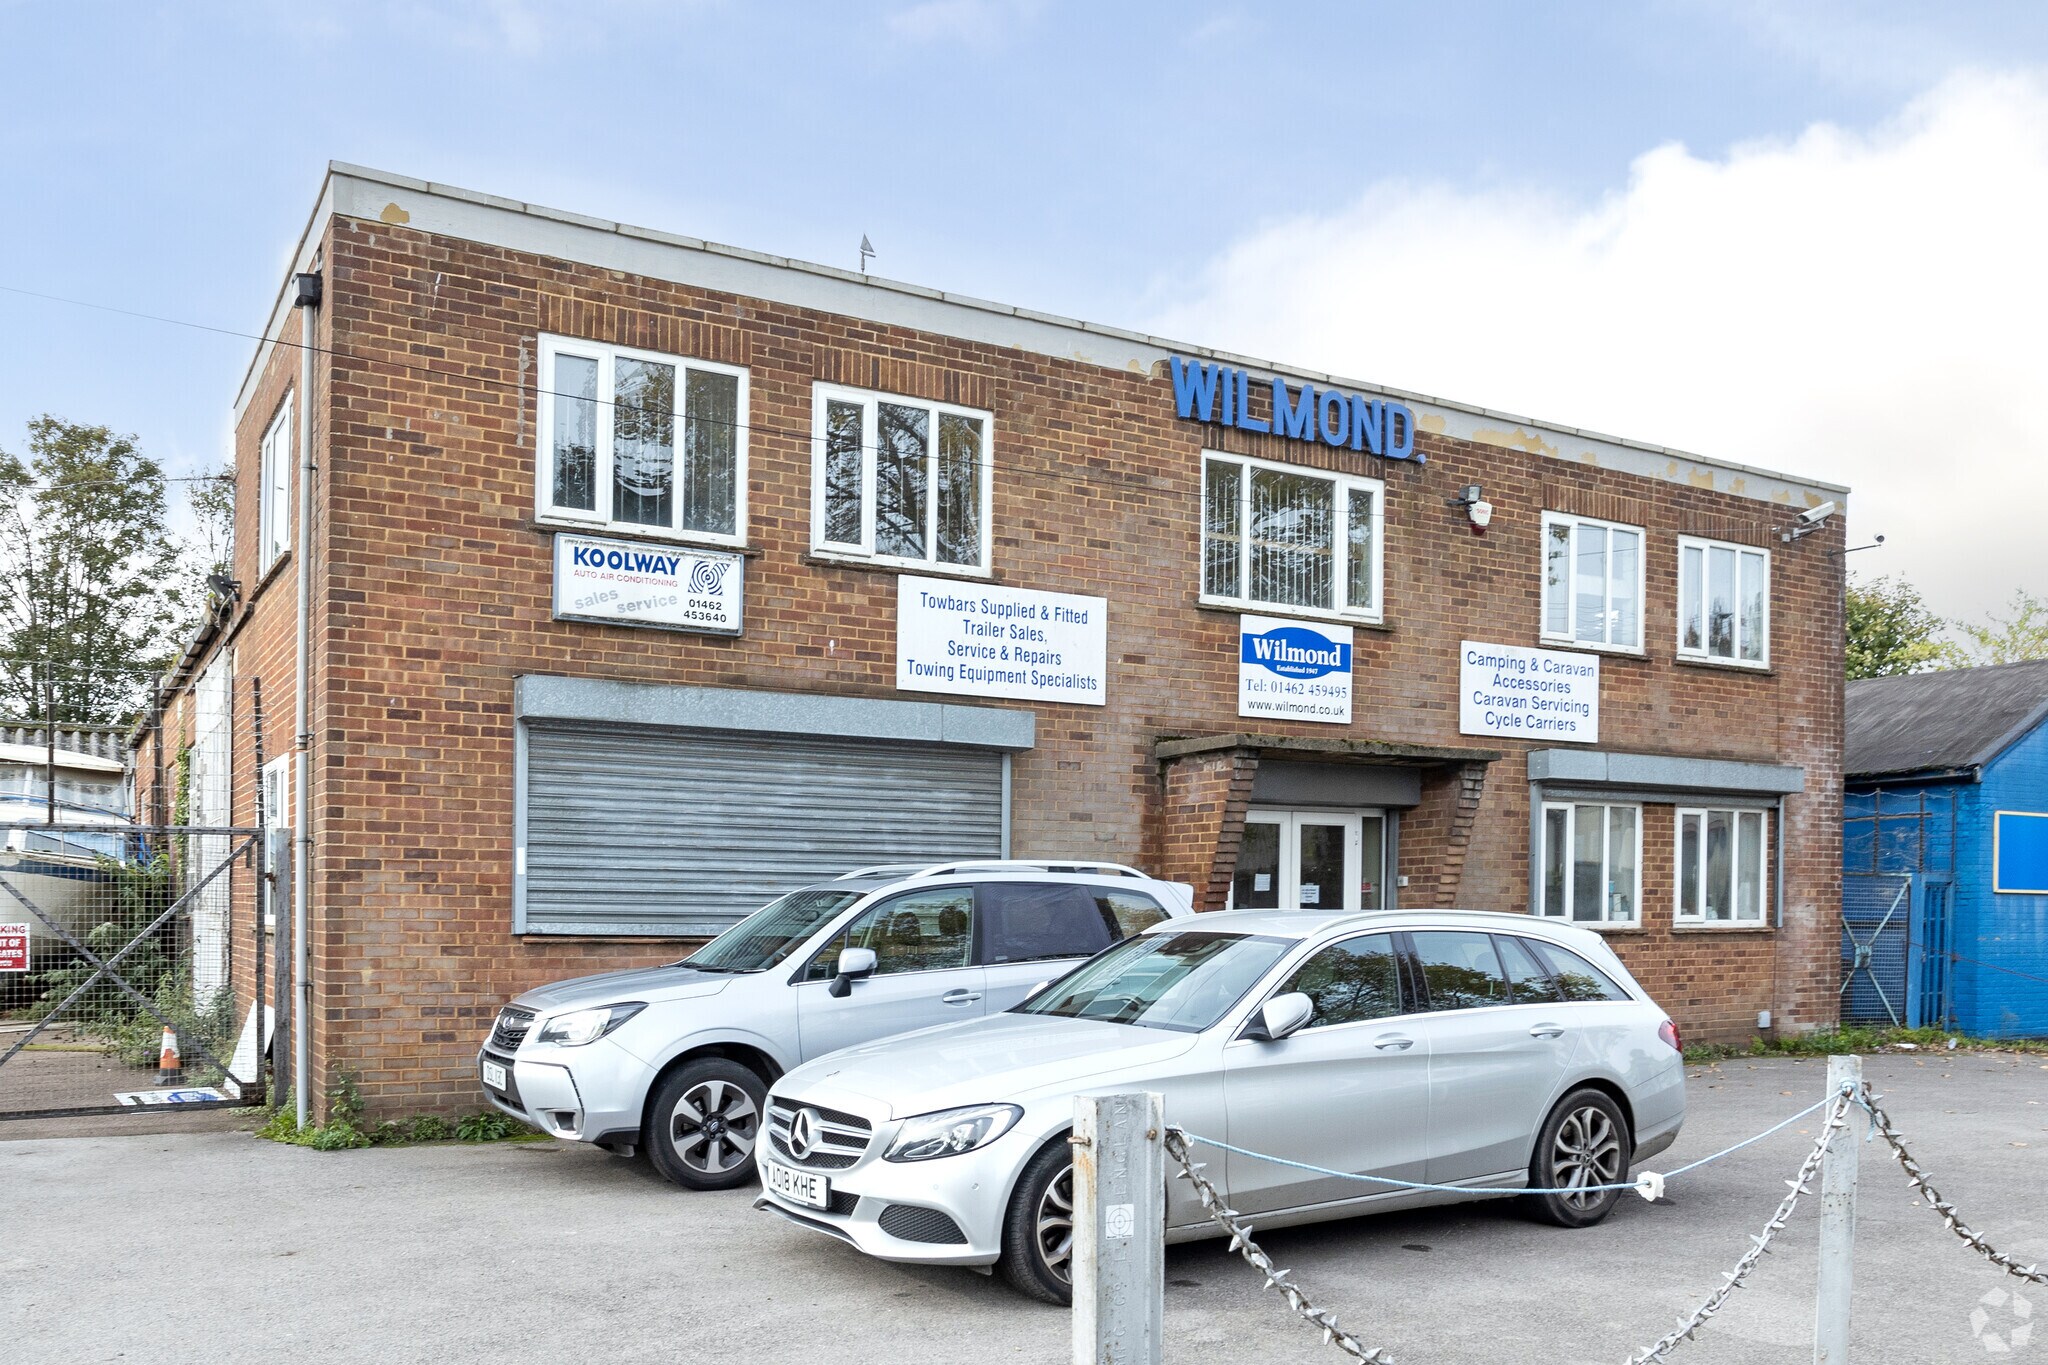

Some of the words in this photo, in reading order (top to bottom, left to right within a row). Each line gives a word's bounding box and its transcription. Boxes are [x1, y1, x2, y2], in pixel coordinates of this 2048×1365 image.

[573, 546, 682, 576] KOOLWAY
[574, 569, 598, 579] AUTO
[600, 572, 615, 581] AIR
[616, 574, 678, 588] CONDITIONING
[574, 588, 618, 610] sales
[616, 594, 678, 614] service
[689, 599, 722, 611] 01462
[920, 592, 976, 612] Towbars
[981, 598, 1036, 620] Supplied
[1040, 606, 1050, 620] &
[1054, 607, 1088, 624] Fitted
[684, 610, 727, 623] 453640
[964, 620, 1004, 638] Trailer
[1010, 624, 1048, 644] Sales,
[948, 640, 996, 659] Service
[1000, 645, 1009, 660] &
[1015, 647, 1062, 666] Repairs
[1252, 638, 1341, 666] Wilmond
[907, 659, 954, 681] Towing
[960, 664, 1026, 684] Equipment
[1031, 670, 1098, 690] Specialists
[1467, 651, 1526, 674] Camping
[1530, 658, 1539, 672] &
[1544, 659, 1594, 677] Caravan
[1246, 678, 1267, 692] Tel:
[1270, 680, 1304, 694] 01462
[1308, 684, 1347, 698] 459495
[1493, 673, 1570, 693] Accessories
[1248, 700, 1344, 716] www.wilmond.co.uk
[1473, 691, 1527, 709] Caravan
[1531, 696, 1589, 717] Servicing
[1485, 711, 1521, 729] Cycle
[1526, 714, 1576, 732] Carriers
[793, 1173, 817, 1199] KHE
